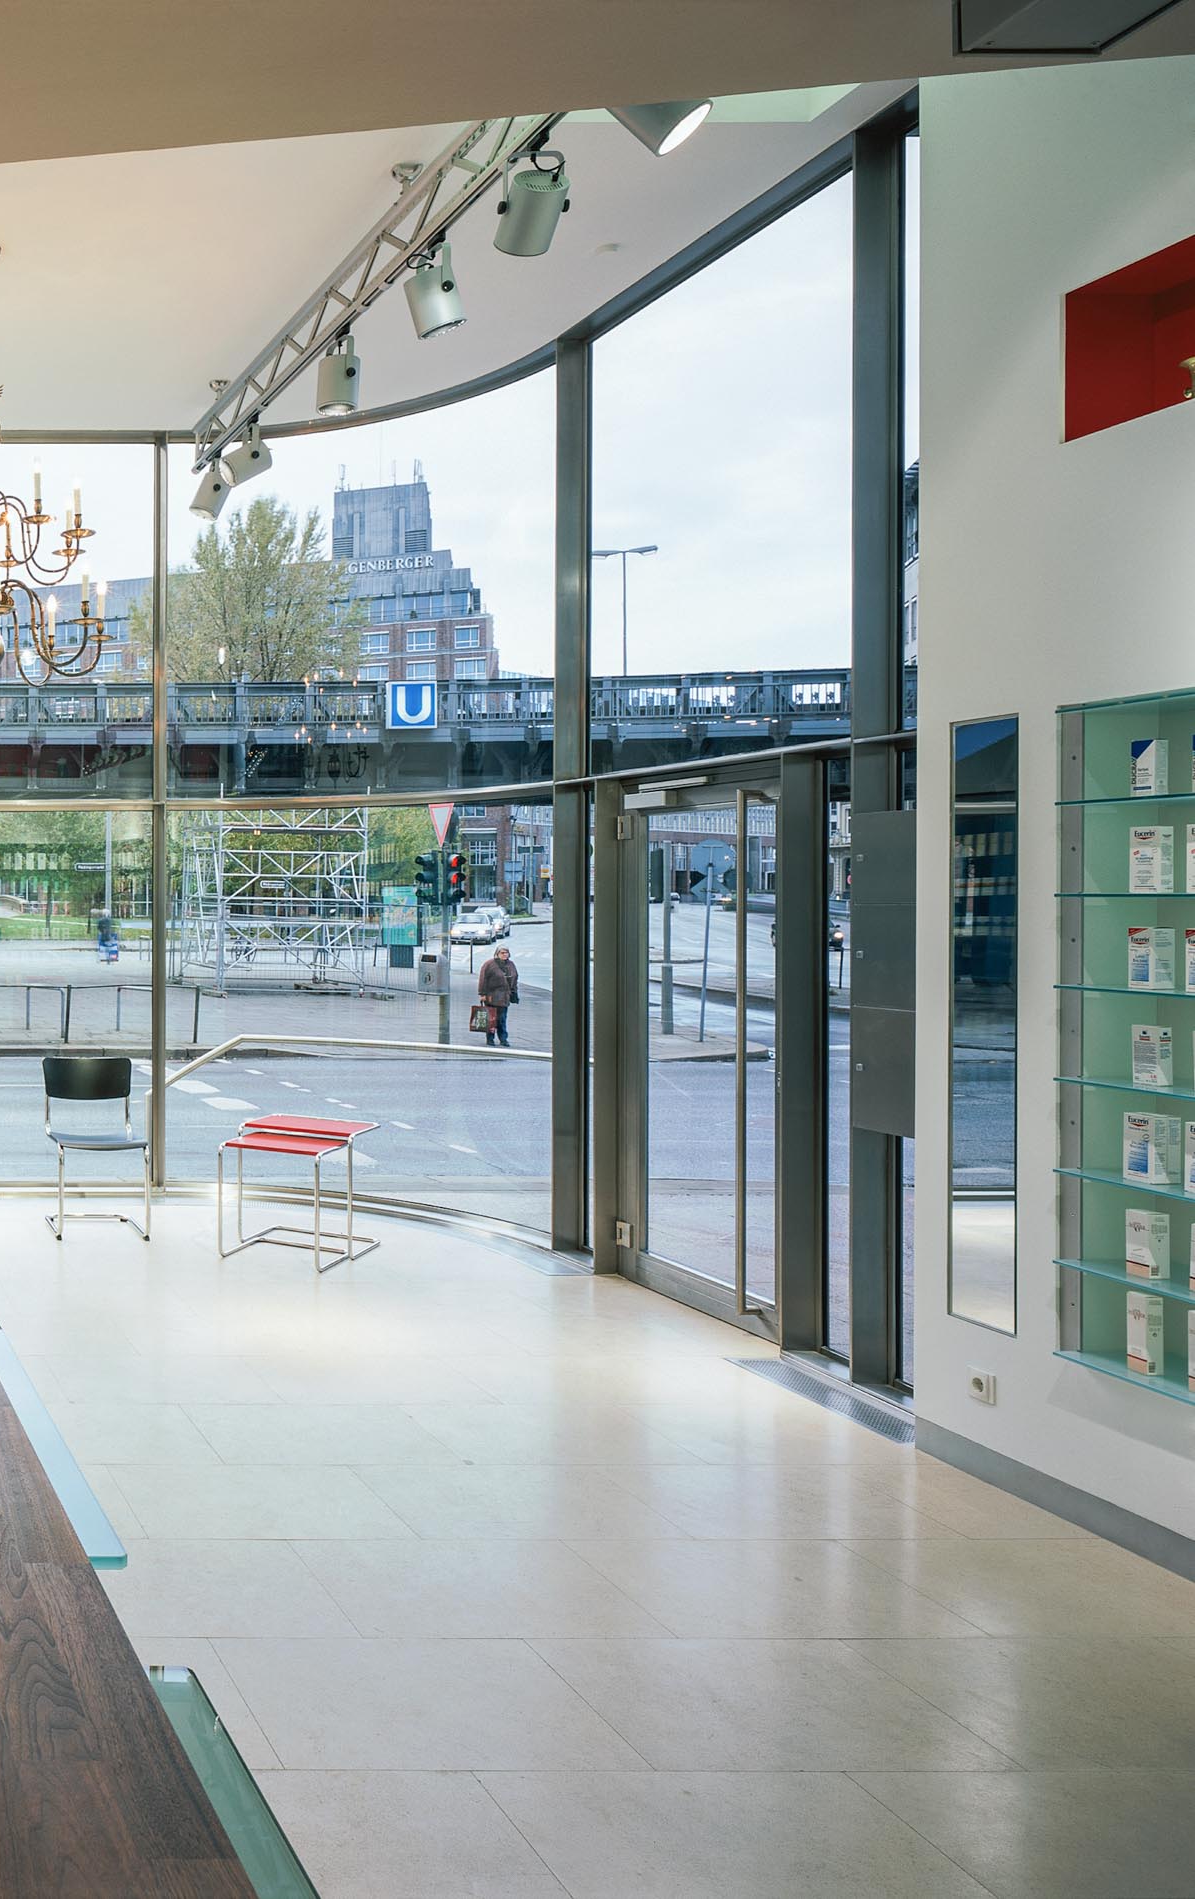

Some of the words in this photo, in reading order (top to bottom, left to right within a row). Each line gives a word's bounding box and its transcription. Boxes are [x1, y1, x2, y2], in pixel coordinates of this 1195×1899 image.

[344, 555, 434, 575] GENBERGER
[396, 686, 431, 724] U
[1128, 1115, 1149, 1125] Eucerin
